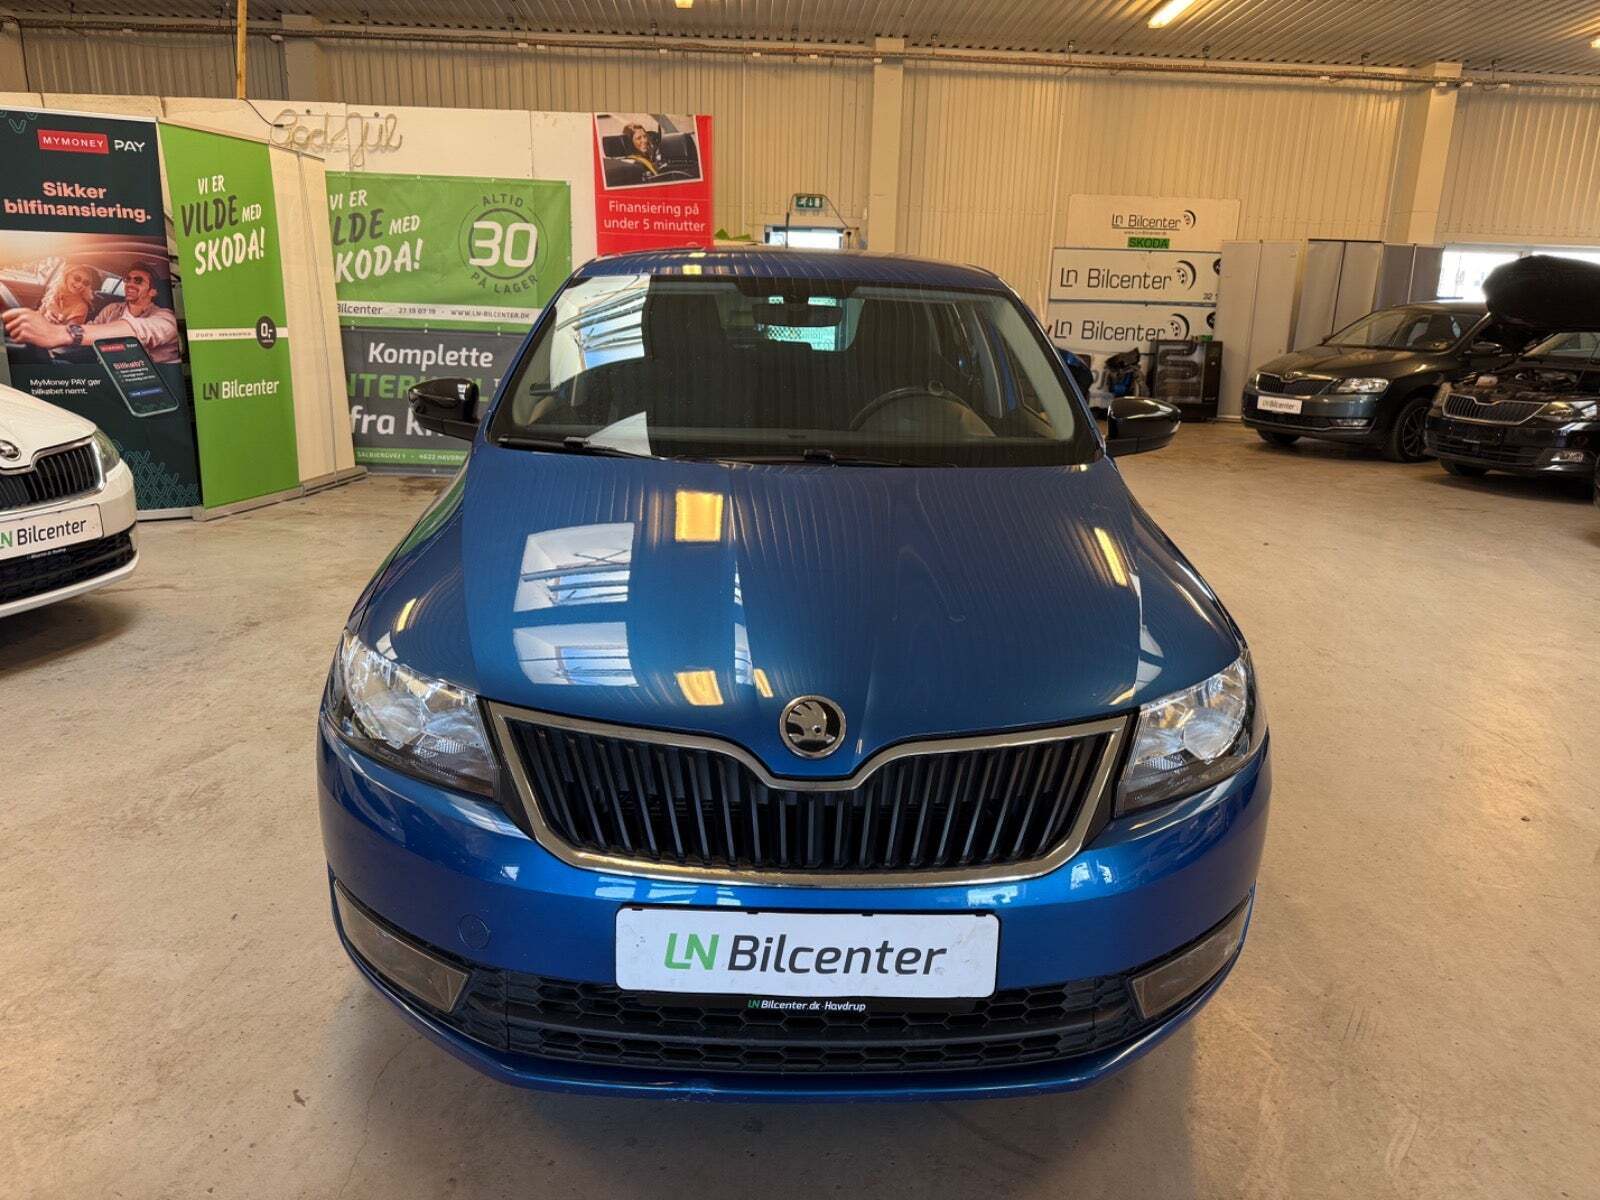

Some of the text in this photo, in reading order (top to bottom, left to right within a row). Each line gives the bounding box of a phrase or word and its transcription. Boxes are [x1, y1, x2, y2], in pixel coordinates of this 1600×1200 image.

[42, 135, 146, 152] MYMONEY PAY
[42, 181, 107, 199] Sikker
[197, 174, 226, 195] VI ER
[329, 189, 369, 210] VI ER
[482, 192, 525, 208] ALTID
[608, 200, 699, 218] Finansiering på
[4, 200, 152, 223] bilfinansiering.
[180, 194, 262, 237] VILDE MED
[1127, 214, 1181, 229] Bilcenter
[332, 208, 421, 246] LDE MED
[603, 217, 706, 233] under 5 minutter
[194, 228, 265, 275] SKODA!
[468, 220, 538, 268] 30
[1128, 237, 1169, 249] SKODA
[334, 238, 424, 284] KODA!
[493, 274, 539, 295] LAGER
[1087, 268, 1172, 290] Bilcenter
[1081, 320, 1166, 342] Bilcenter
[369, 343, 493, 372] Komplette
[30, 379, 68, 388] MyMoney
[71, 378, 86, 386] PAY
[203, 379, 279, 400] LN Bilcenter
[350, 405, 395, 435] fra
[17, 519, 87, 546] Bilcenter
[664, 933, 947, 975] LN Bilcenter
[747, 1000, 760, 1009] LN
[824, 1002, 866, 1013] Havdrup
